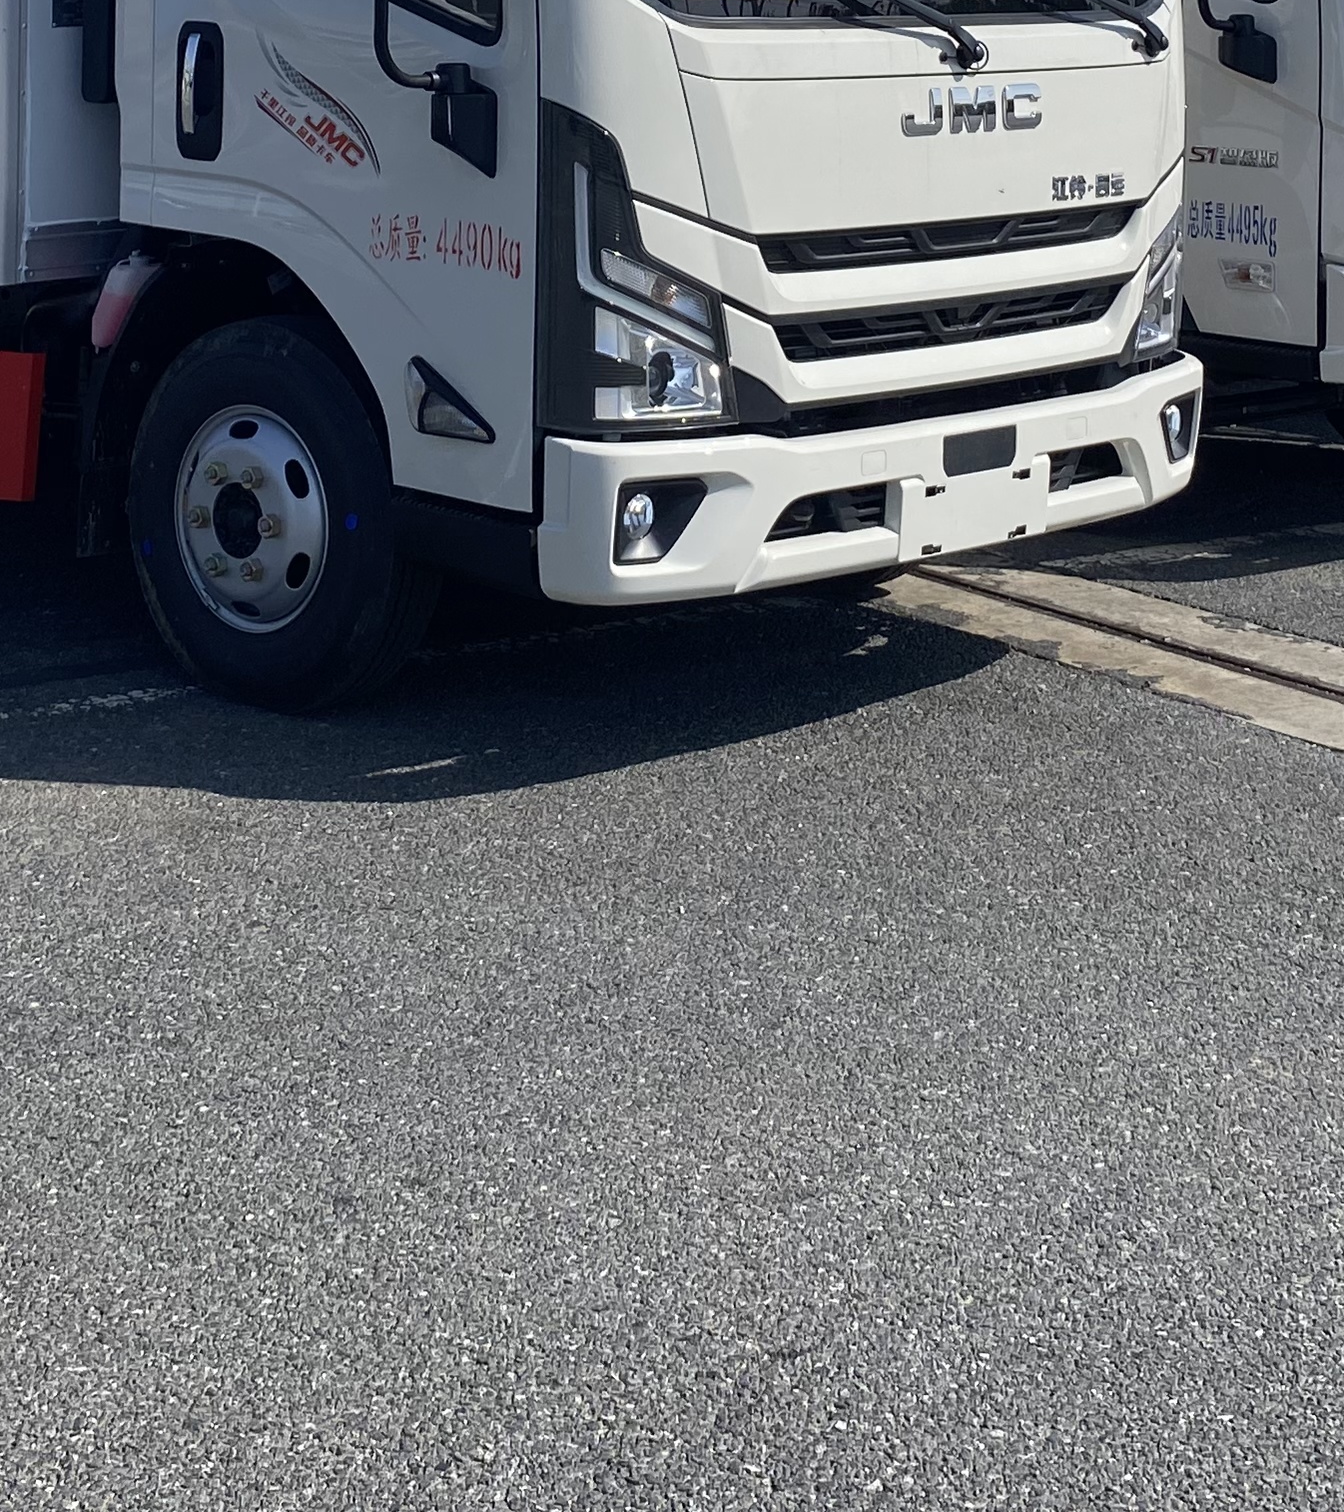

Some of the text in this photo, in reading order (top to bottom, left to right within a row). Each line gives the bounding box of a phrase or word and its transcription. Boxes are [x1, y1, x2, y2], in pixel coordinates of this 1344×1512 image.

[901, 83, 1042, 137] JMC
[304, 113, 365, 168] JMC
[1189, 146, 1218, 163] S1
[1187, 199, 1277, 257] 总质量4495kg
